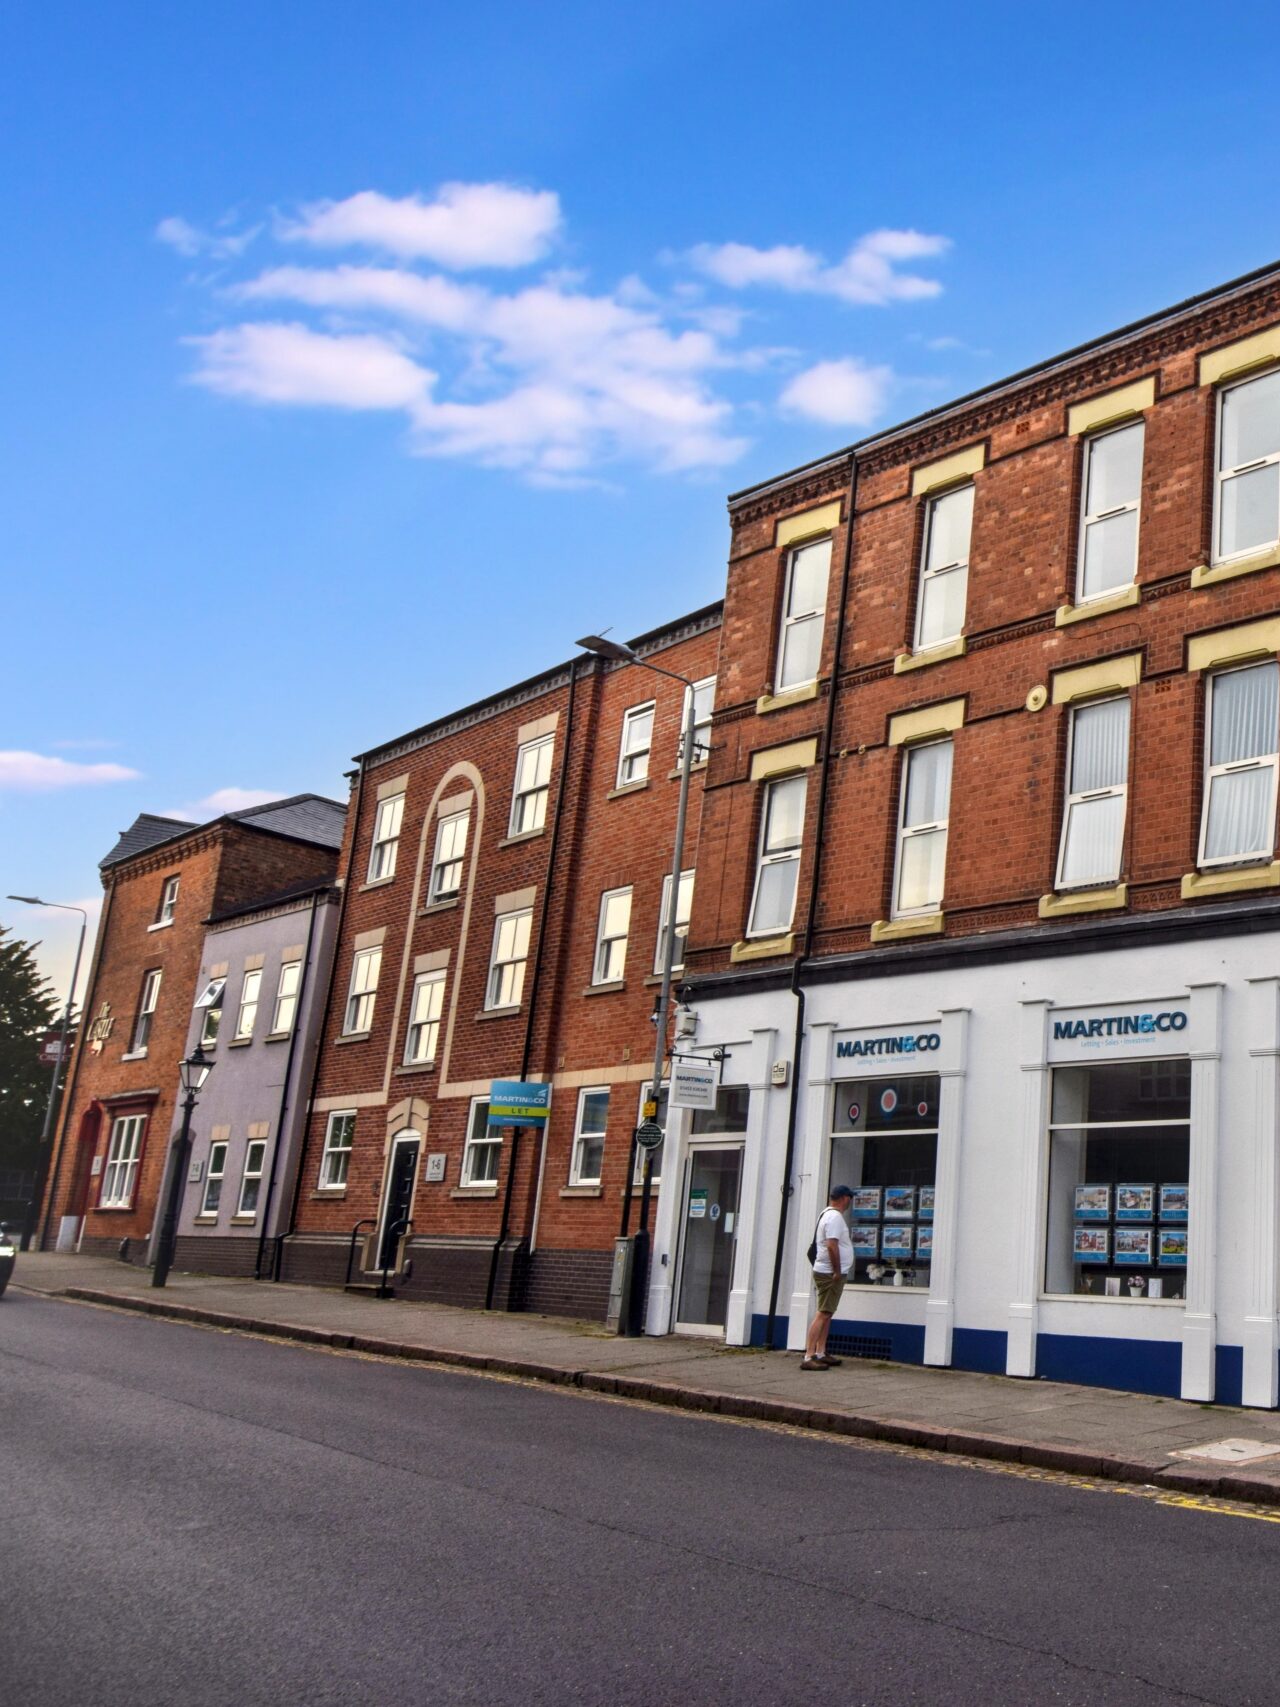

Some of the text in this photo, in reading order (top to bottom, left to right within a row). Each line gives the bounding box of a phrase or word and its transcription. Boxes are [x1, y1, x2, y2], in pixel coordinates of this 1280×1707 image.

[1053, 1011, 1188, 1040] MARTIN&CO
[836, 1033, 941, 1058] MARTIN&CO
[494, 1095, 546, 1104] MARTIN&CO
[511, 1107, 529, 1115] LET
